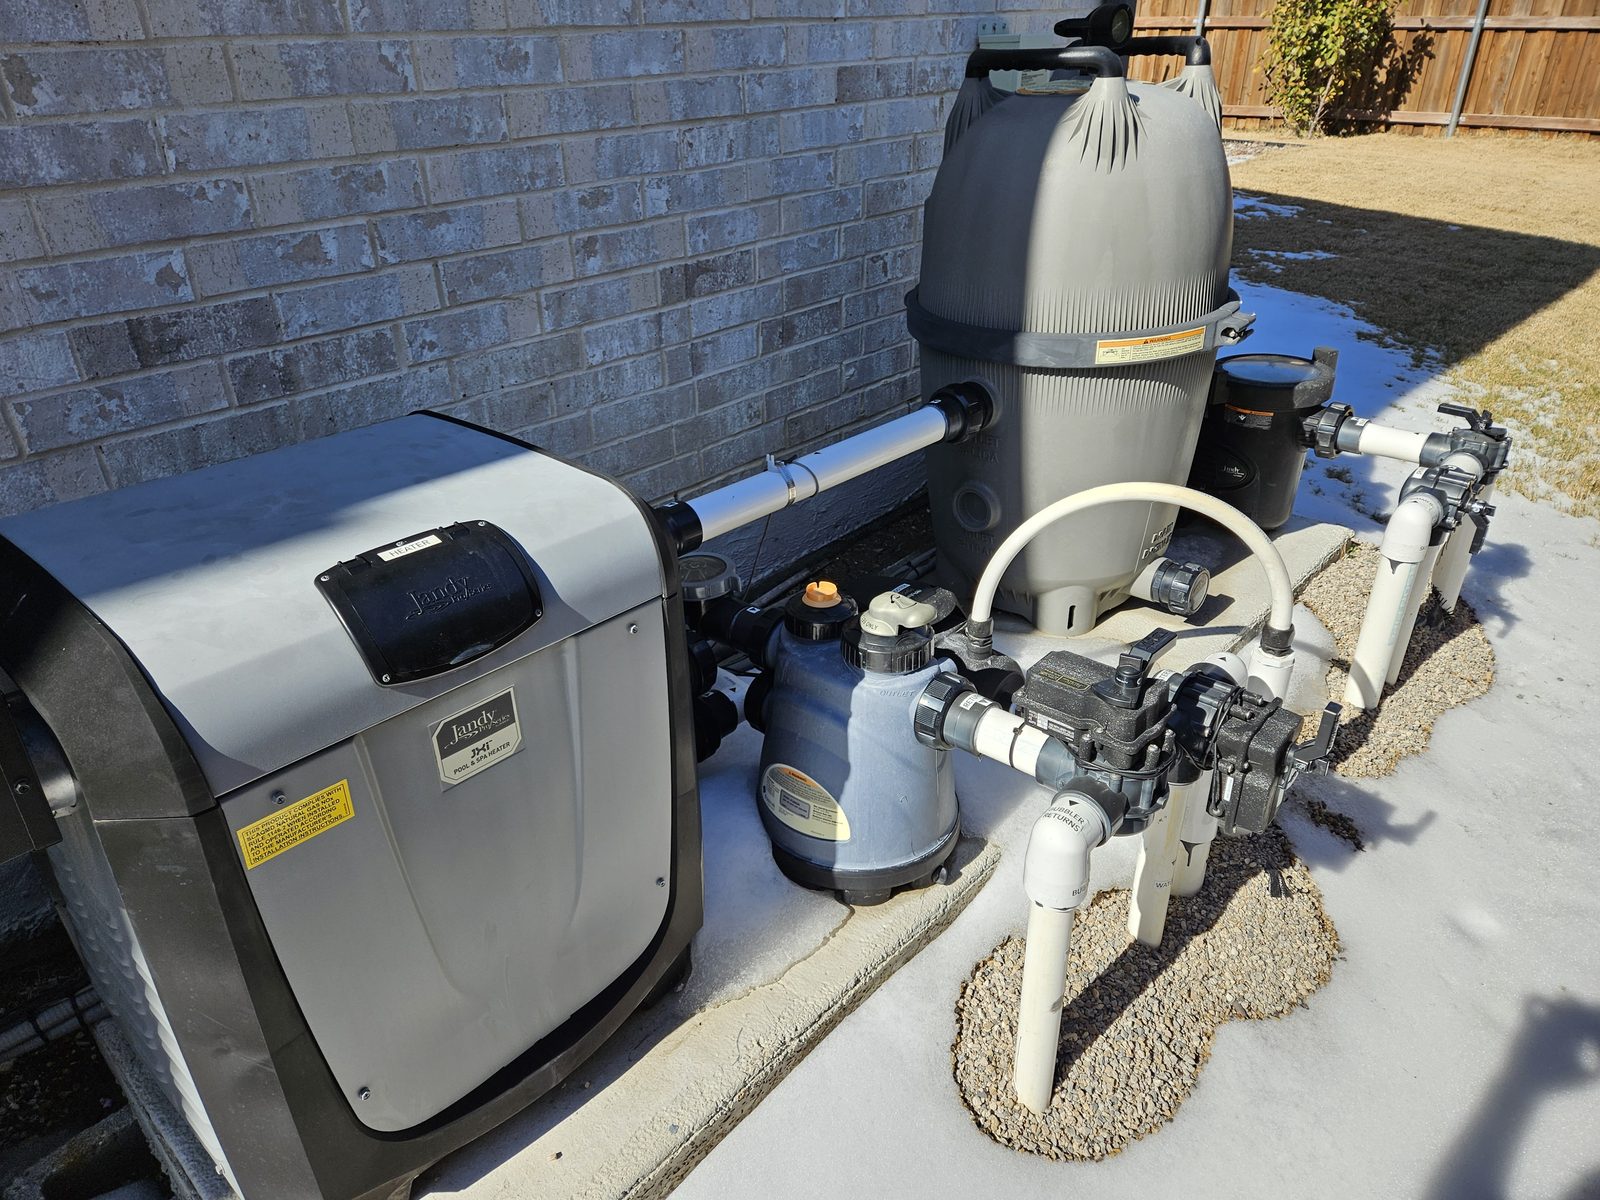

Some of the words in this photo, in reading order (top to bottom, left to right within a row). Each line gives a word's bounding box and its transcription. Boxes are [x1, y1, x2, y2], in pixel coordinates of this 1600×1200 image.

[388, 540, 431, 557] HEATER
[405, 576, 469, 619] Jandy
[444, 710, 495, 750] Jandy
[453, 763, 470, 775] POOL
[476, 755, 488, 764] SPA
[488, 741, 511, 757] HEATER
[245, 826, 260, 836] THIS
[261, 809, 293, 829] PRODUCT
[293, 794, 326, 813] COMPLIES
[325, 787, 342, 797] WITH
[246, 824, 275, 841] SCAQMD
[276, 810, 305, 827] NATURAL
[306, 802, 321, 811] GAS
[248, 836, 266, 847] RULE
[267, 826, 286, 838] 1146.2
[287, 816, 307, 828] WHEN
[307, 798, 341, 818] INSTALLED
[250, 842, 264, 852] AND
[264, 824, 300, 845] OPERATED
[300, 805, 337, 827] ACCORDING
[251, 849, 261, 857] TO
[261, 842, 275, 853] THE
[275, 813, 332, 846] MANUFACTURER'S
[252, 837, 298, 863] INSTALLATION
